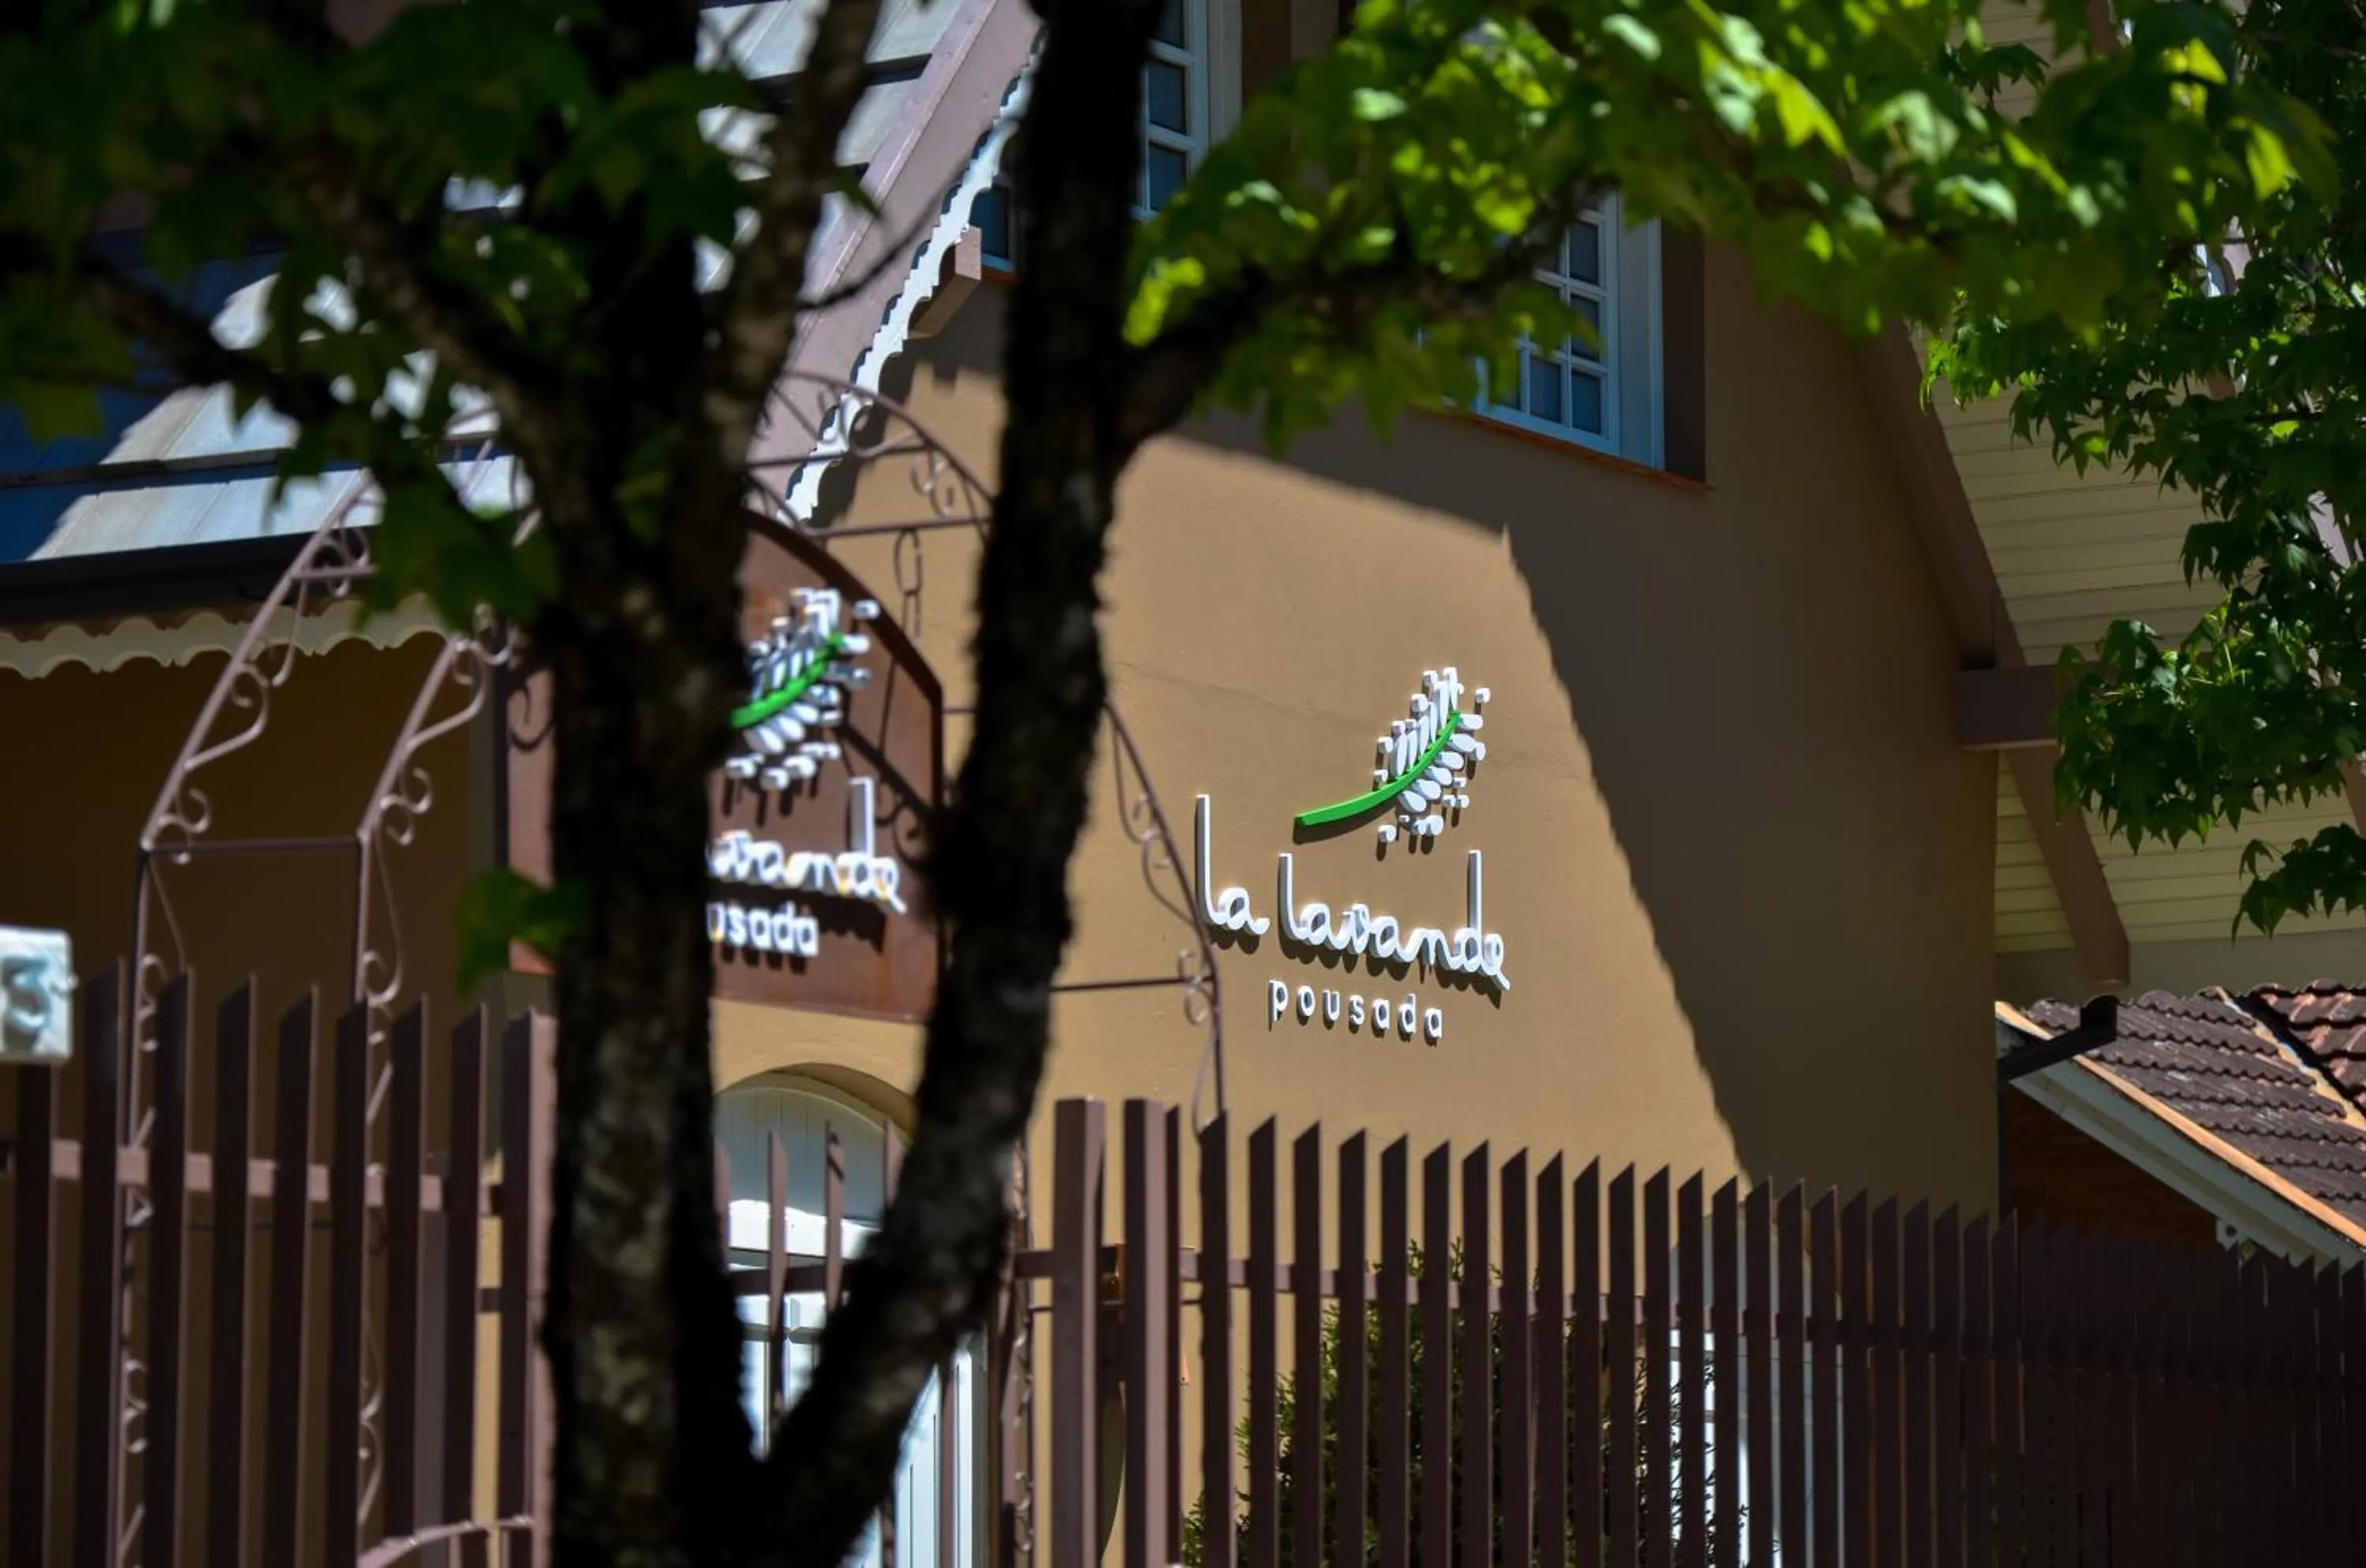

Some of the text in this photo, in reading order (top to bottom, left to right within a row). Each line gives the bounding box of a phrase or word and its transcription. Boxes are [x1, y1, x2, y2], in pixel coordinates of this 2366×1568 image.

[707, 776, 906, 914] vande
[707, 902, 818, 957] usada
[1269, 979, 1442, 1040] pousada
